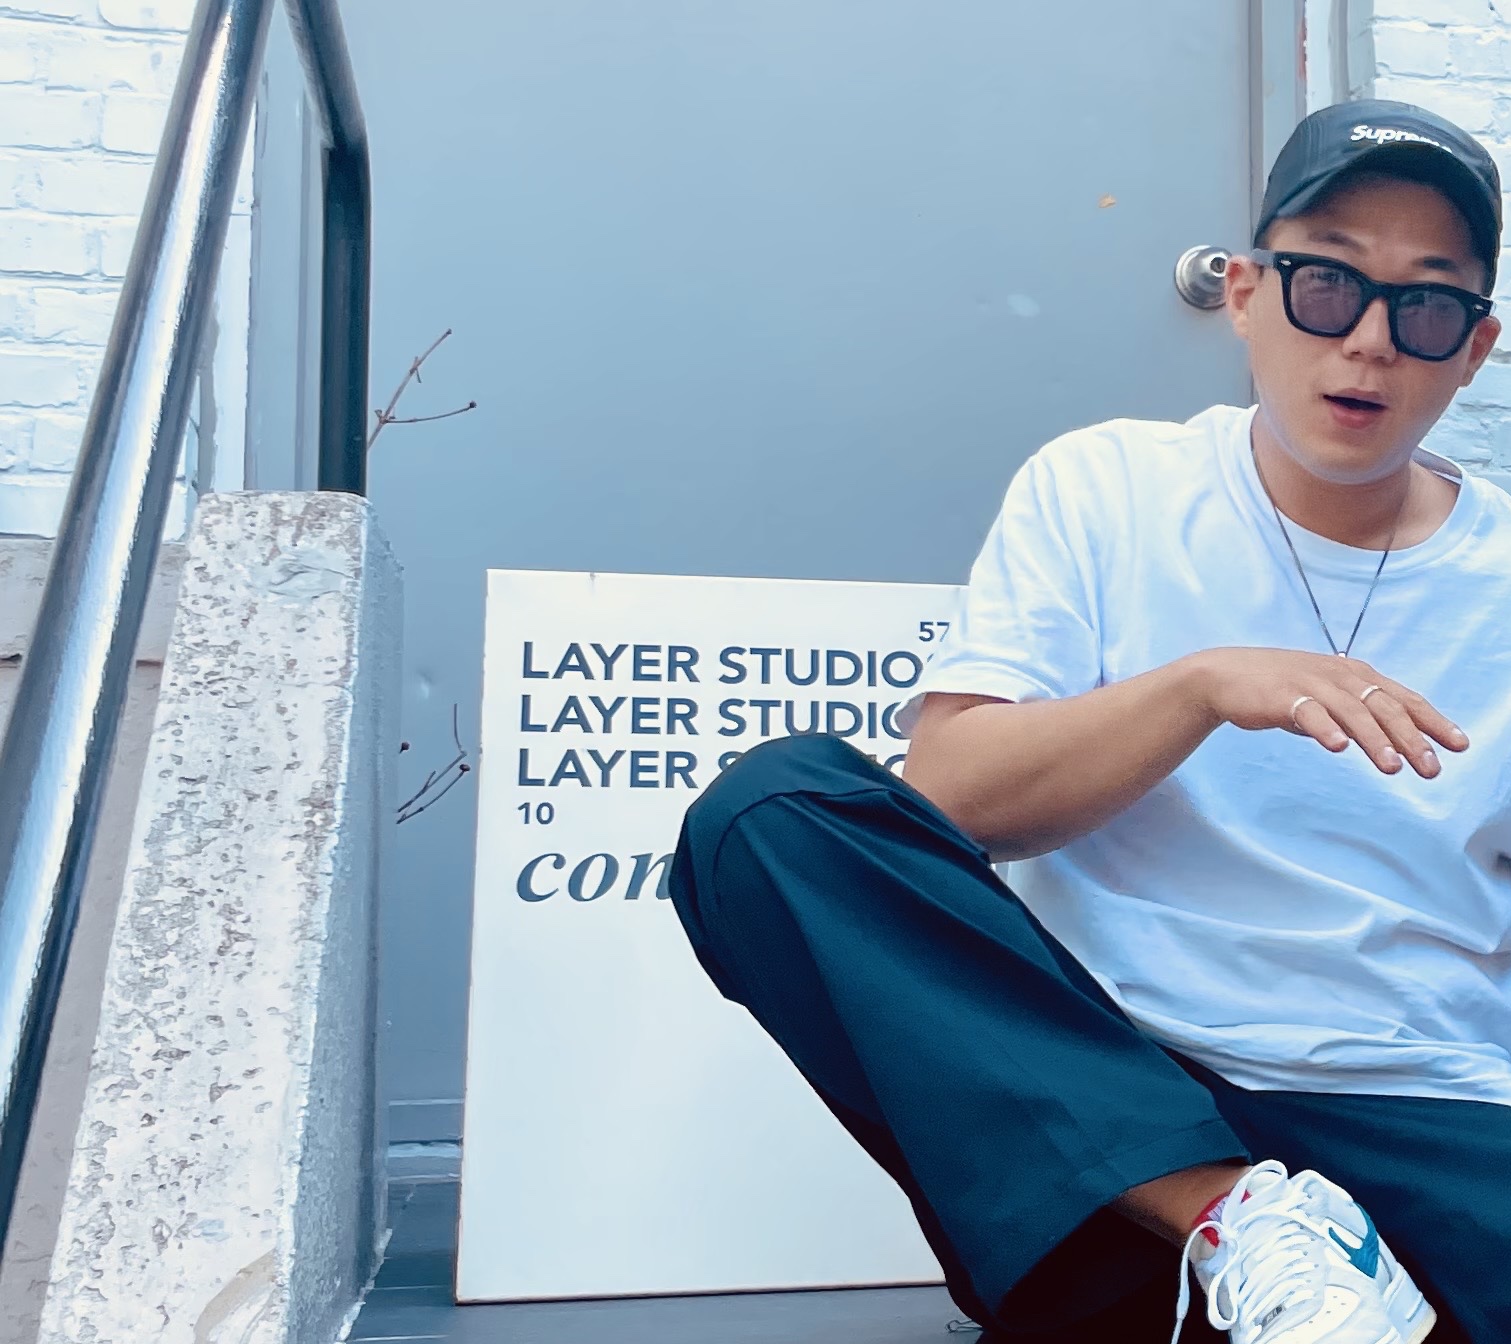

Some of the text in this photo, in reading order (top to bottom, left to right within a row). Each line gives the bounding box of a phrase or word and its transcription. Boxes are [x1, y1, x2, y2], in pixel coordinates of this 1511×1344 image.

[523, 642, 700, 683] LAYER
[521, 694, 699, 735] LAYER
[518, 748, 698, 788] LAYER
[518, 802, 554, 824] 10
